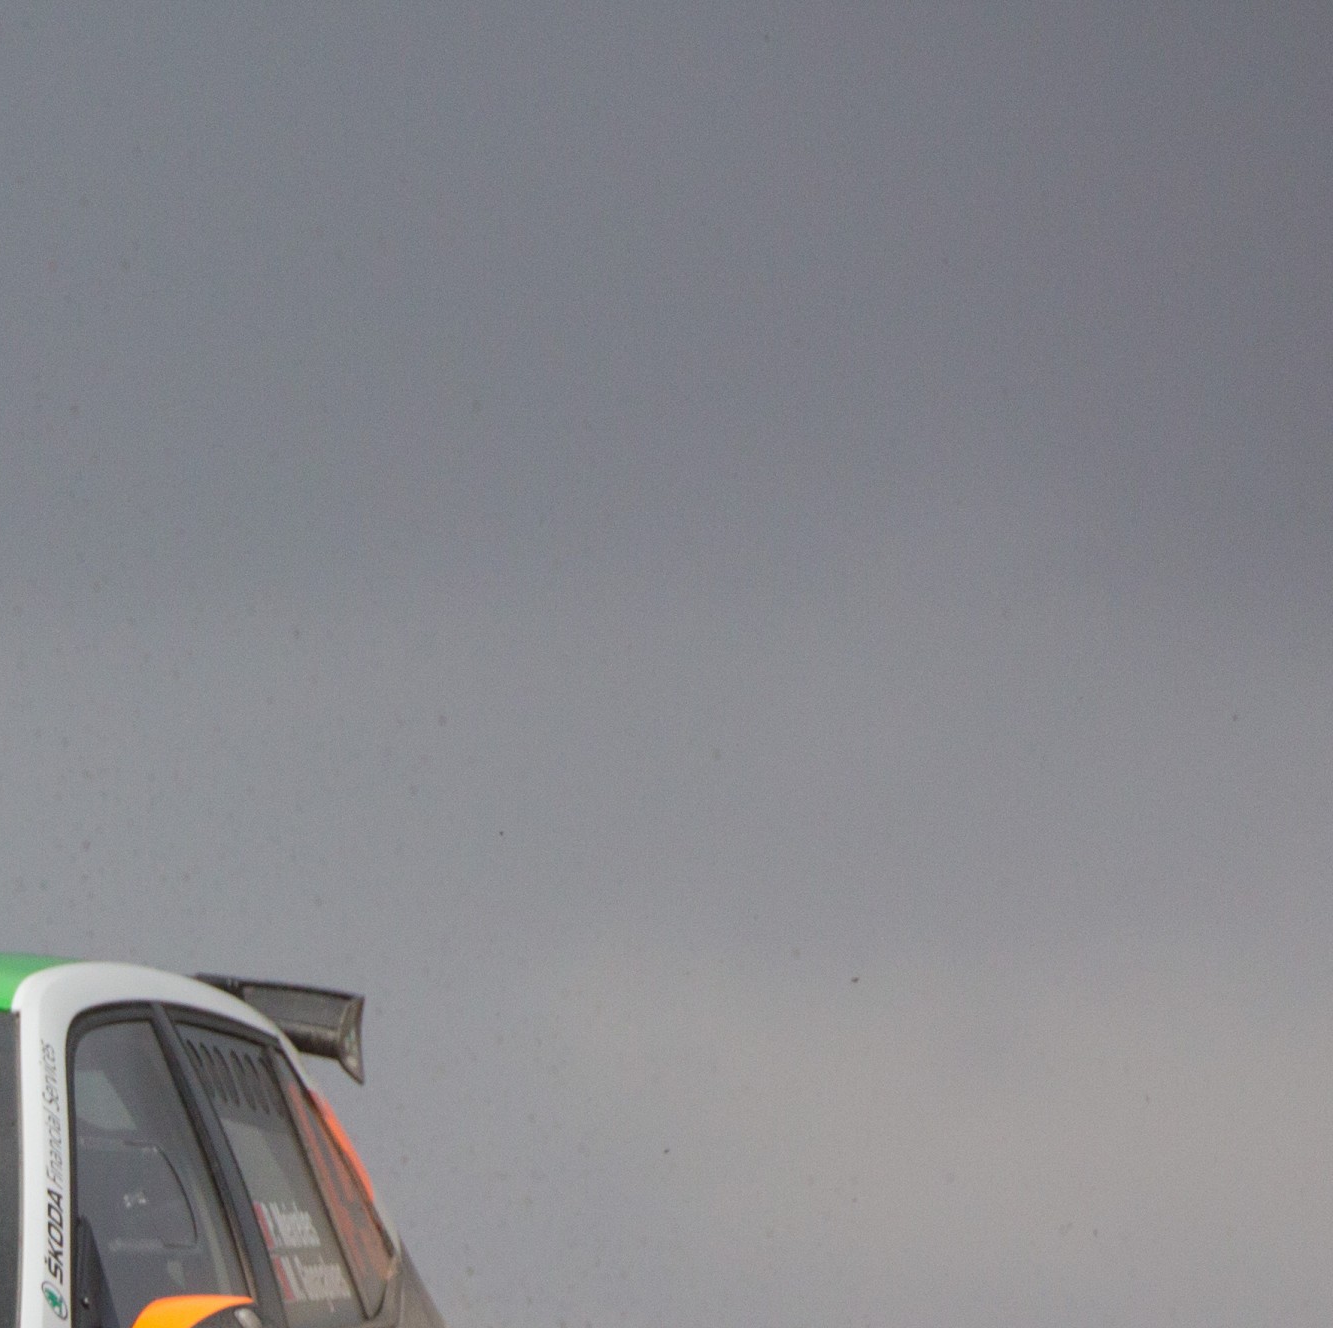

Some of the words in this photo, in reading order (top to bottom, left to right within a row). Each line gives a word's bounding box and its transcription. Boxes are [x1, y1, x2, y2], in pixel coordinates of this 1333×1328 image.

[41, 1041, 61, 1112] Services
[42, 1106, 63, 1190] Financial
[44, 1188, 64, 1286] ŠKODA
